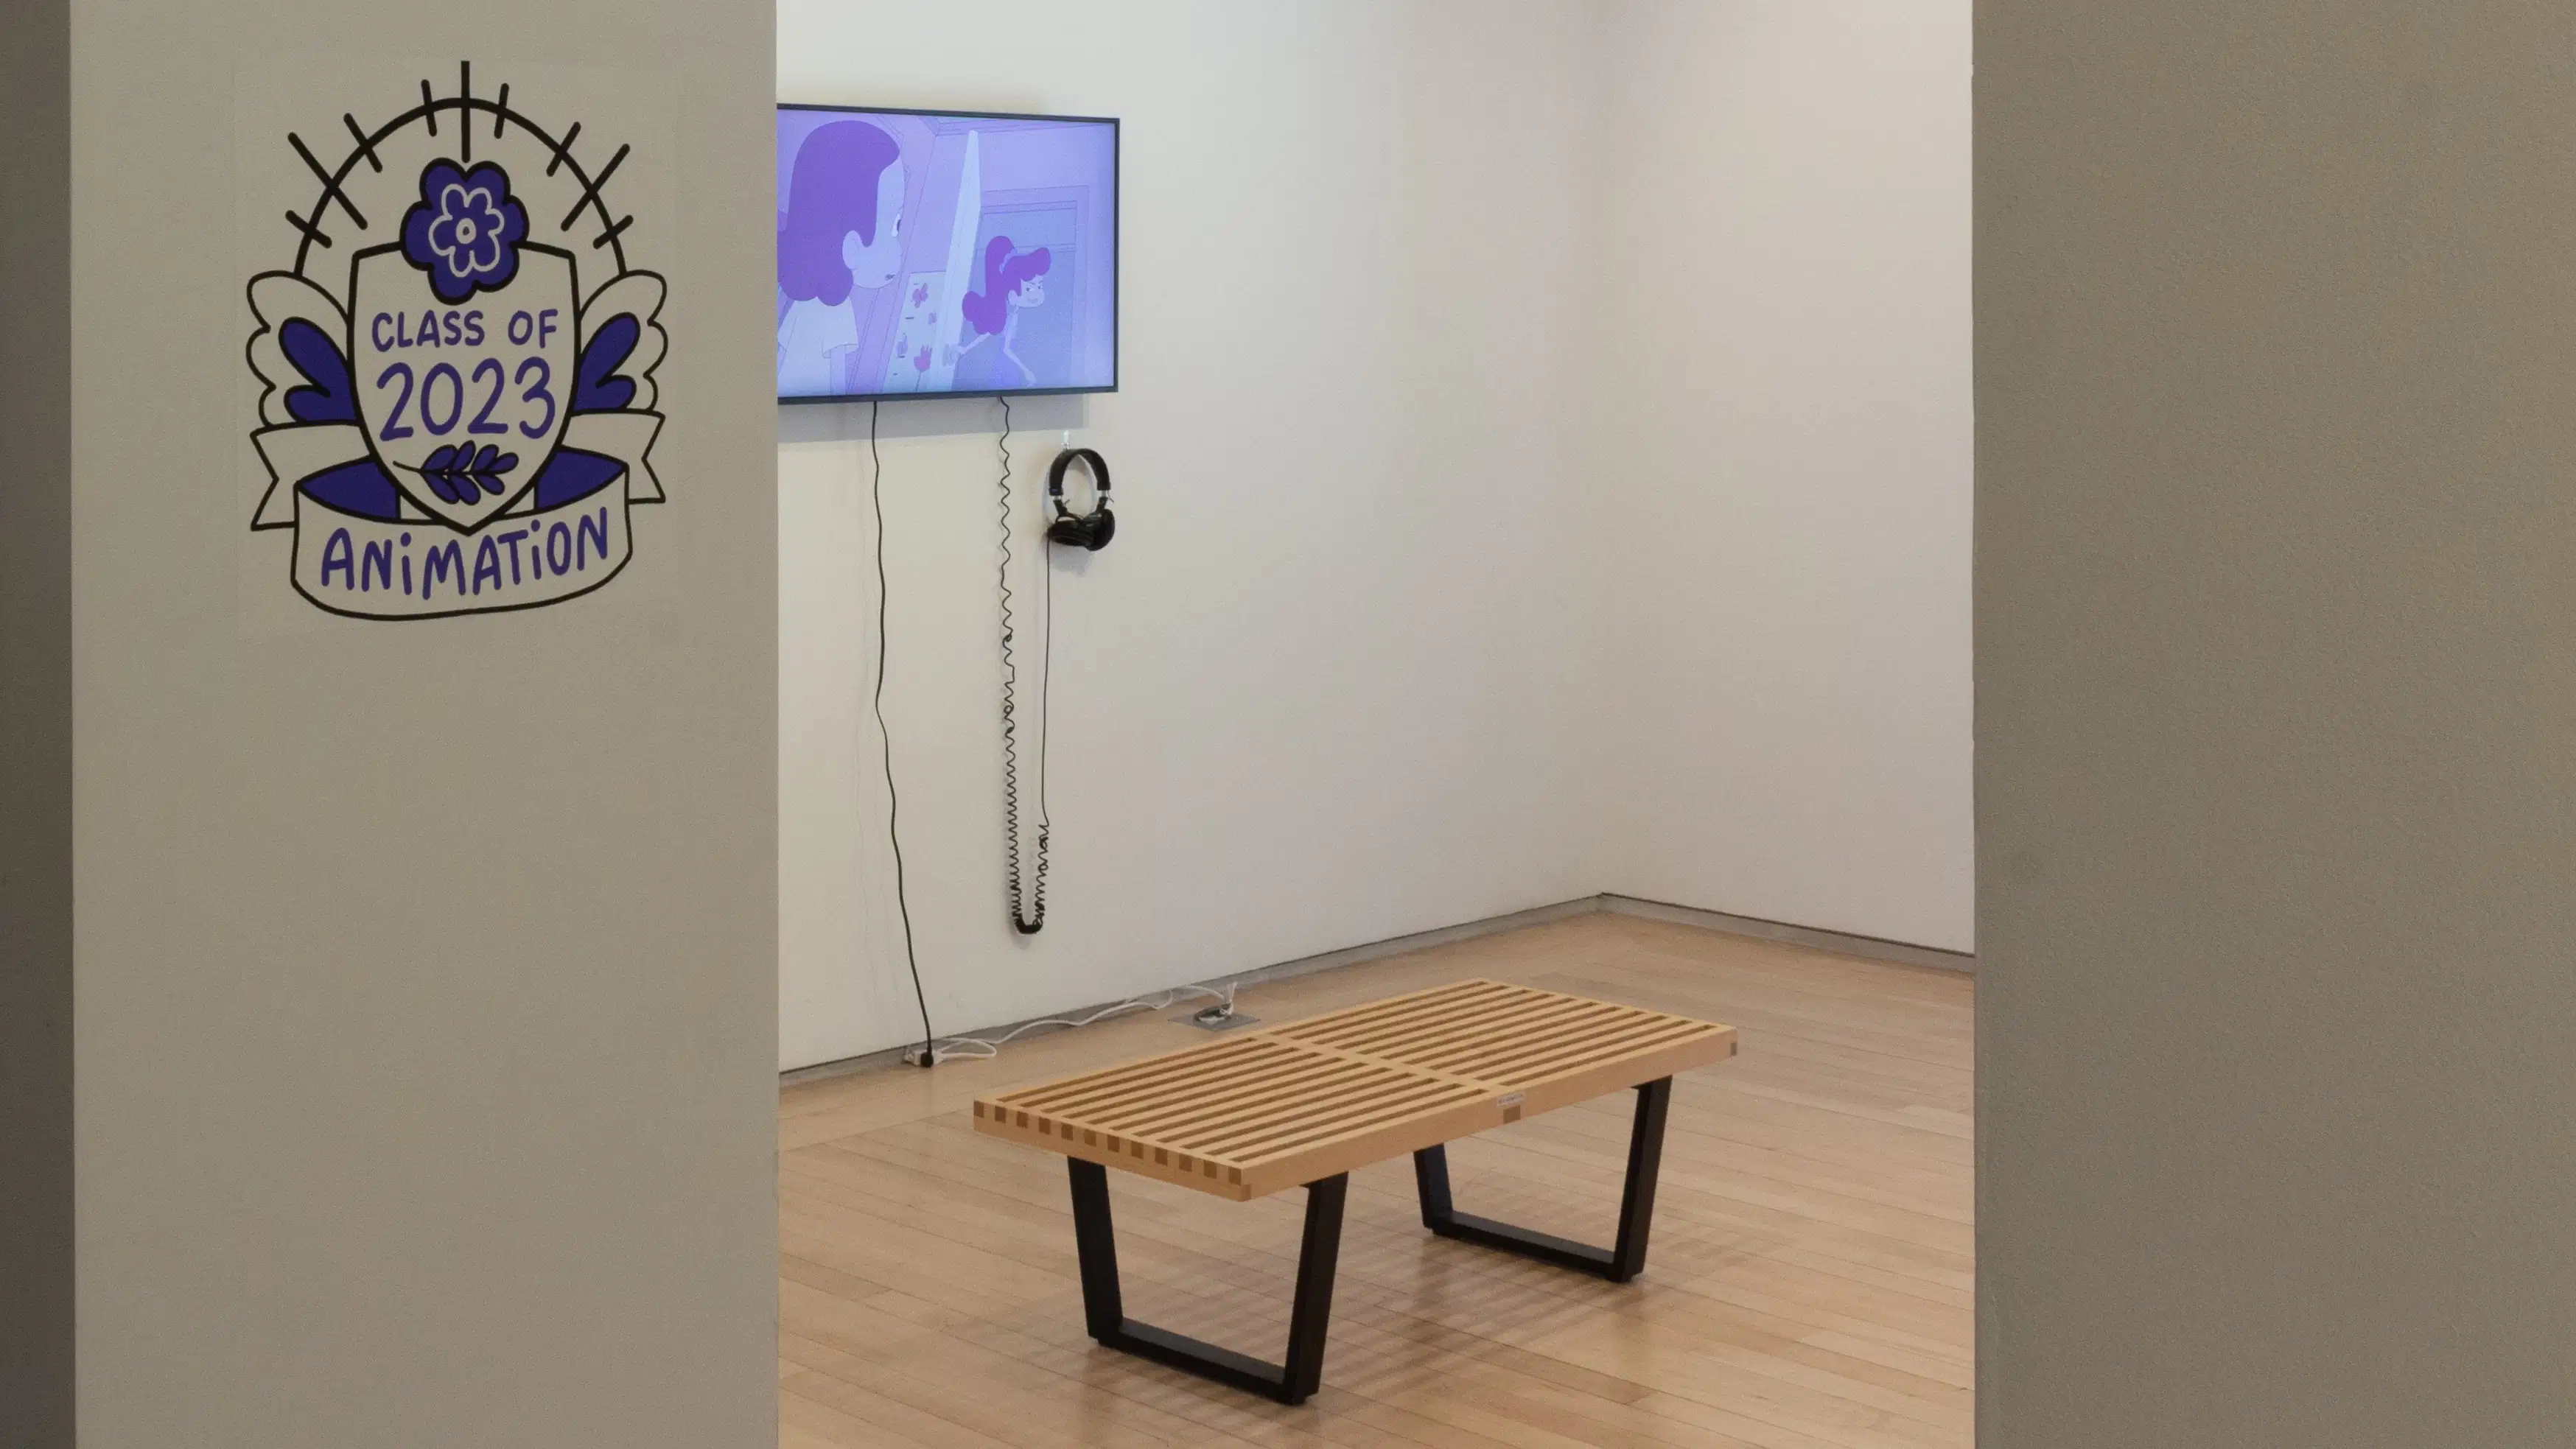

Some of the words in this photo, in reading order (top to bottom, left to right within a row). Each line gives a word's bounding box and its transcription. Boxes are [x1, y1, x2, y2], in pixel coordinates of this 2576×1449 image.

[371, 309, 486, 352] CLASS
[507, 309, 559, 348] OF
[375, 356, 556, 442] 2023
